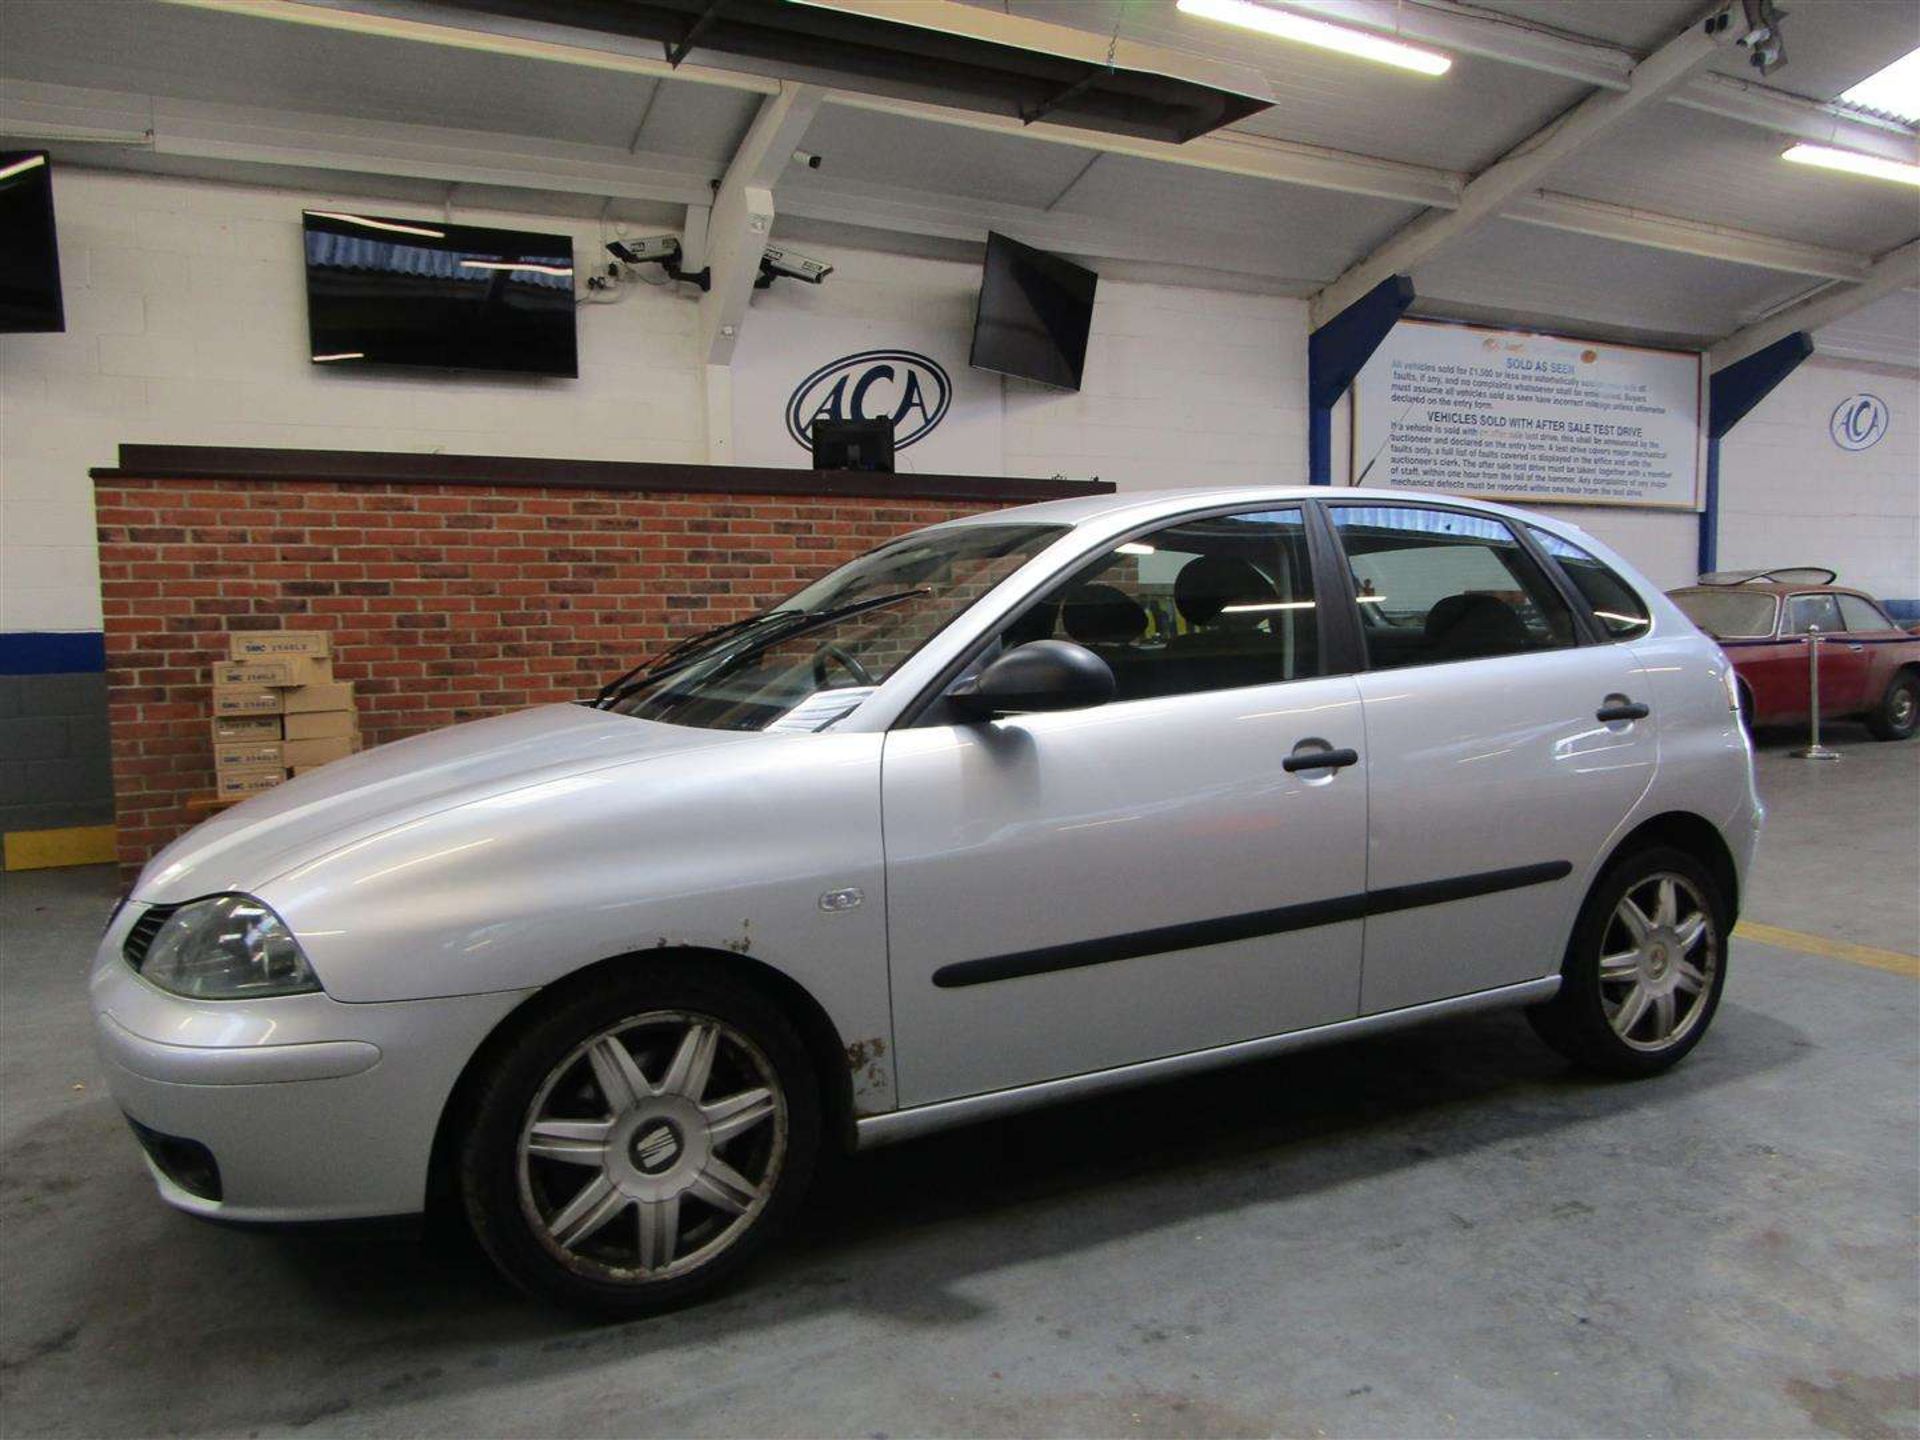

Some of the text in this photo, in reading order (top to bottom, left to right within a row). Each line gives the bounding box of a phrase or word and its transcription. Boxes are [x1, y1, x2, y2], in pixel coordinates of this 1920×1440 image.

[1506, 358, 1575, 374] SOLD AS SEEN
[801, 364, 930, 435] ACA
[1428, 411, 1642, 438] VEHICLES SOLD WITH AFTER SALE TEST DRIVE
[1835, 400, 1880, 443] ACA
